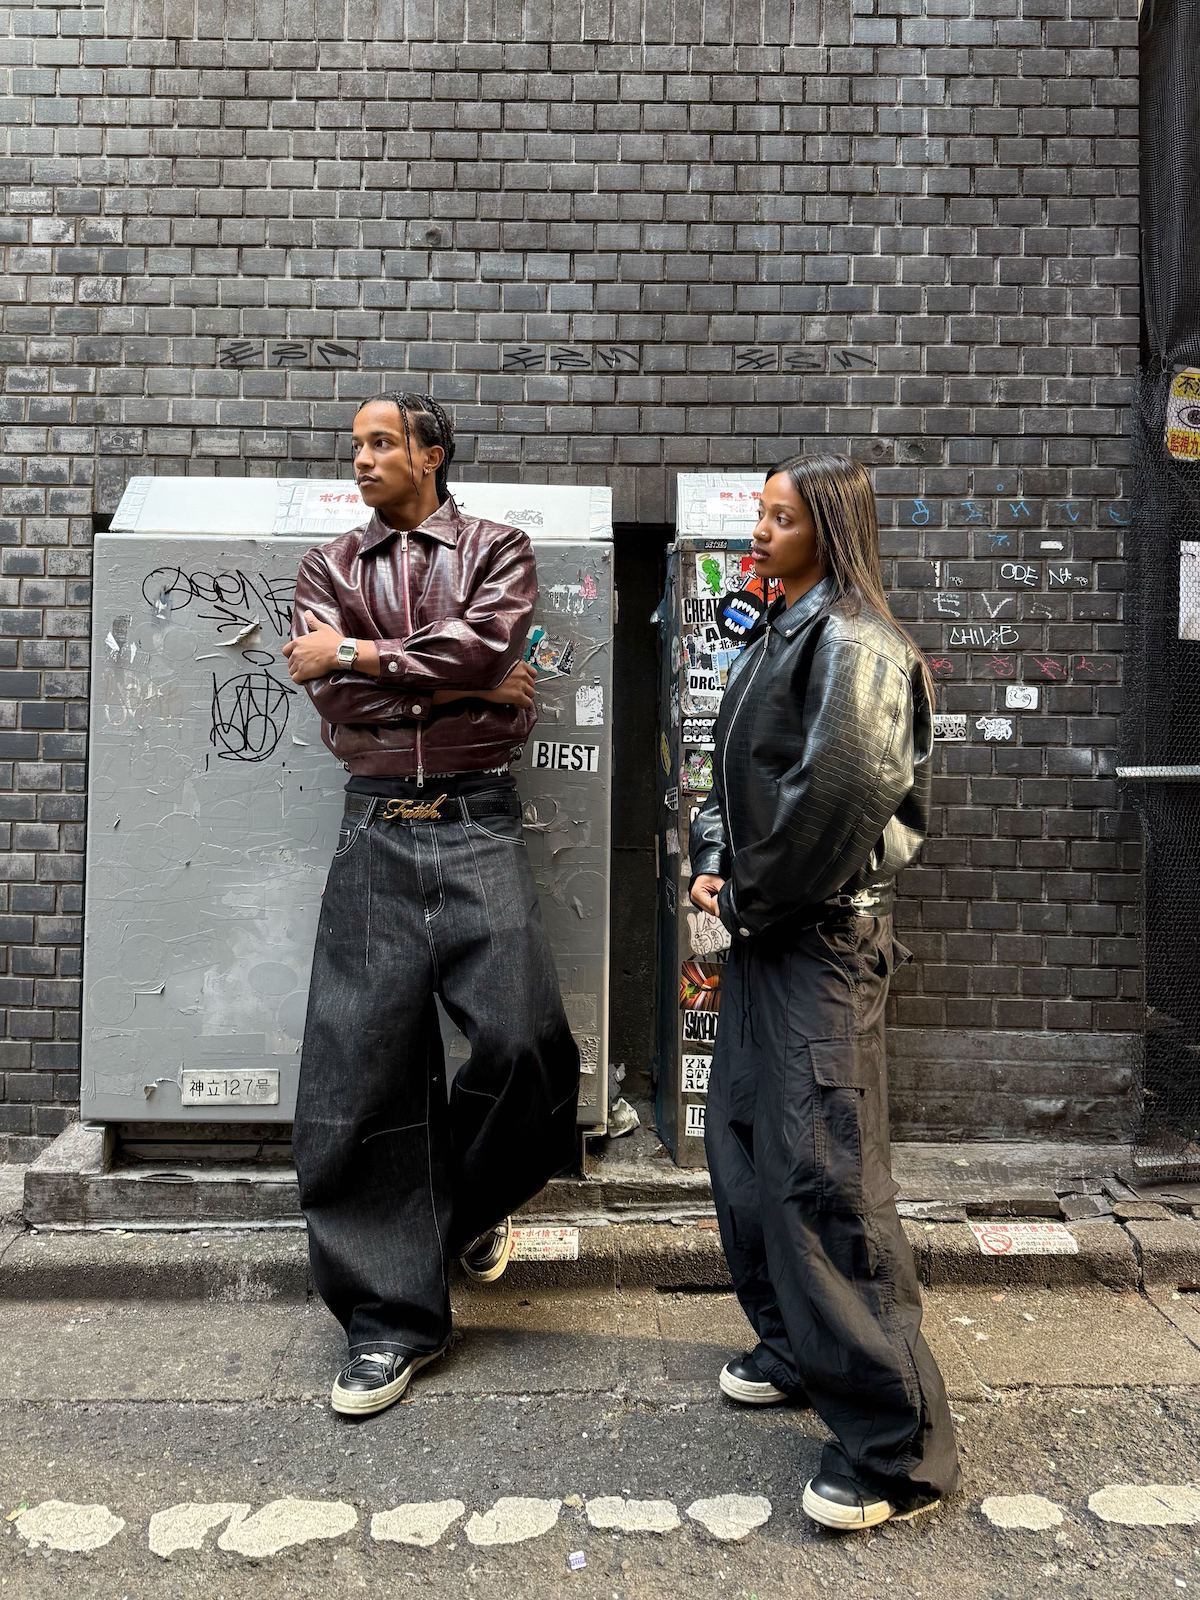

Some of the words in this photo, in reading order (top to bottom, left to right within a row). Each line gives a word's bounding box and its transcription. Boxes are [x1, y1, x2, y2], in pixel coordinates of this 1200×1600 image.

[319, 493, 362, 504] ポイ捨
[537, 742, 597, 771] BIEST
[189, 1078, 271, 1097] 神立127号
